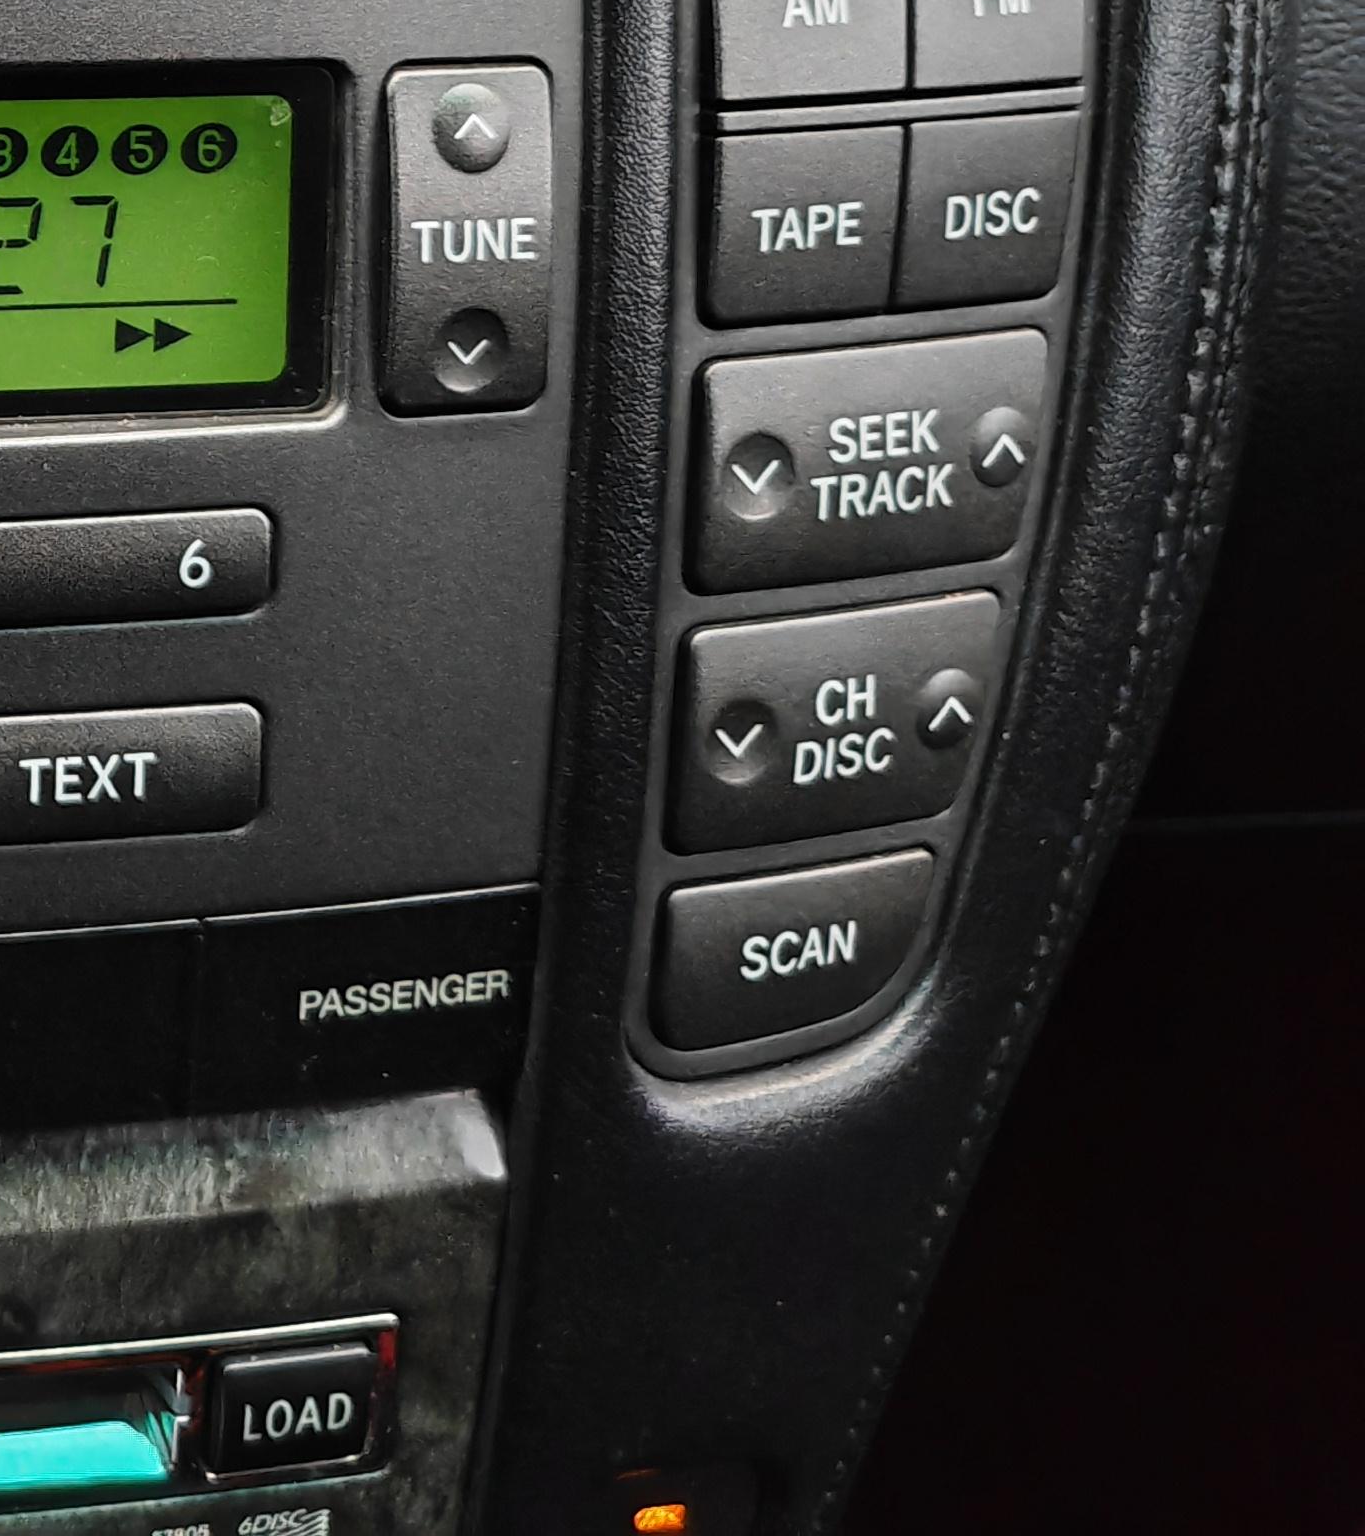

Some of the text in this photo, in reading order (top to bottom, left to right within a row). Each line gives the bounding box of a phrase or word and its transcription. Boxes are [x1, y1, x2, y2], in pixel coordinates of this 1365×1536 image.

[751, 200, 866, 254] TAPE
[943, 185, 1044, 241] DISC
[409, 216, 540, 265] TUNE
[827, 408, 943, 465] SEEK
[809, 462, 956, 523] TRACK
[177, 539, 213, 590] 6
[814, 673, 878, 727] CH
[18, 752, 157, 806] TEXT
[792, 726, 898, 787] DISC
[739, 919, 859, 983] SCAN
[297, 969, 512, 1023] PASSENGER
[241, 1391, 355, 1442] LOAD
